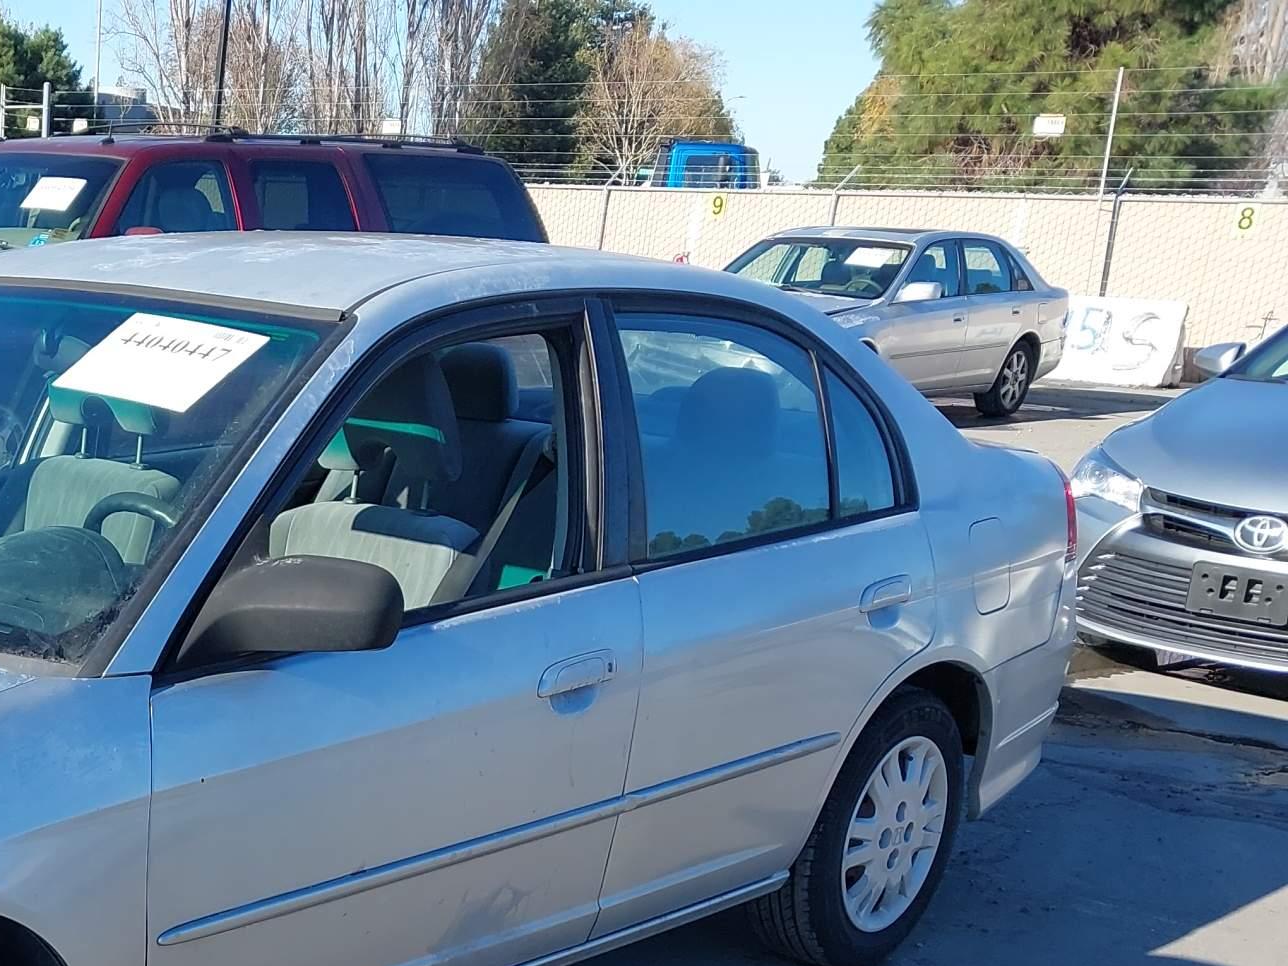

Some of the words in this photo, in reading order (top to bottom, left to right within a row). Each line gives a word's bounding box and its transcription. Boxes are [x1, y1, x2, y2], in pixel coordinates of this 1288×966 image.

[712, 195, 724, 215] 9
[1238, 207, 1255, 230] 8
[121, 332, 232, 361] 44040447
